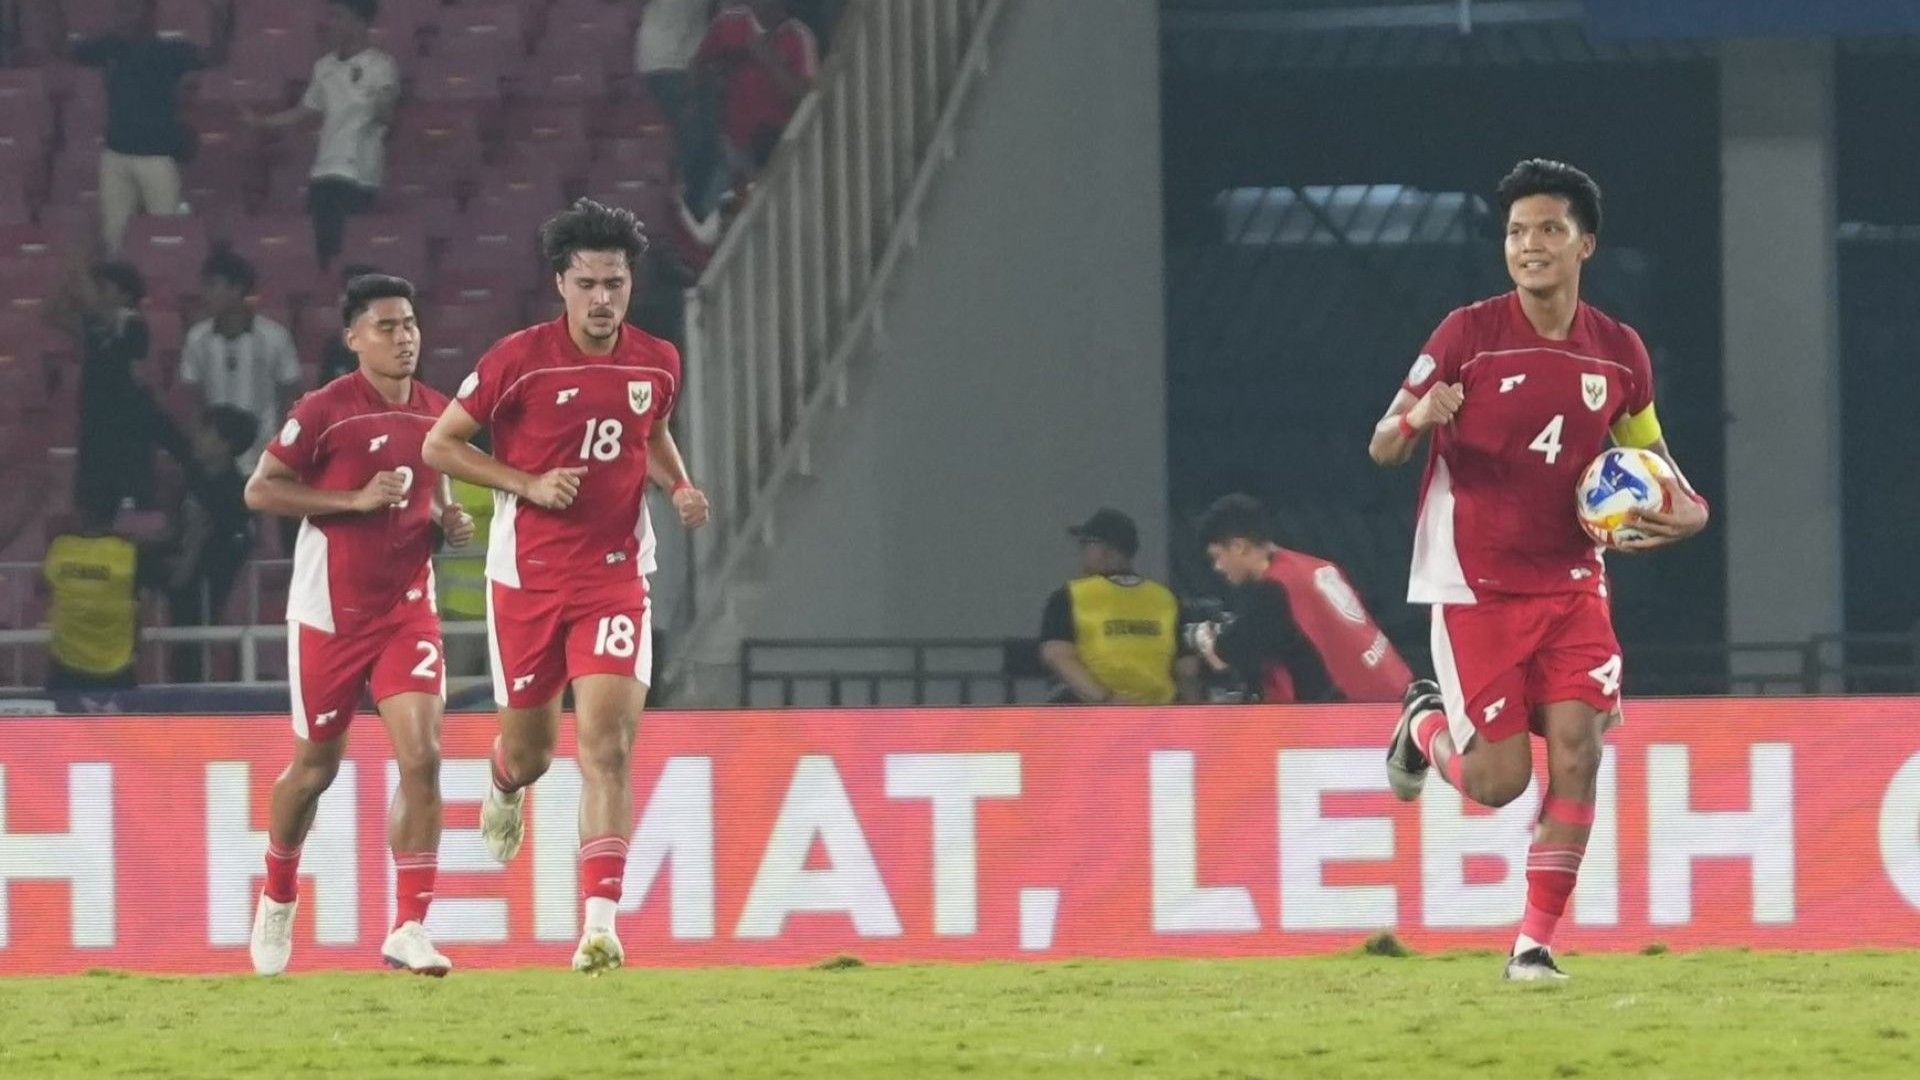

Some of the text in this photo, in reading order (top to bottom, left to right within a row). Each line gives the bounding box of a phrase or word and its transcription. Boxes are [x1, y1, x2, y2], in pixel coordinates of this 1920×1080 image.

[580, 418, 622, 461] 18
[1528, 414, 1564, 464] 4
[594, 614, 635, 657] 18
[410, 640, 438, 678] 2
[1587, 654, 1621, 696] 4
[205, 752, 1060, 951] HEMAT,
[1150, 742, 1796, 935] LEBIH
